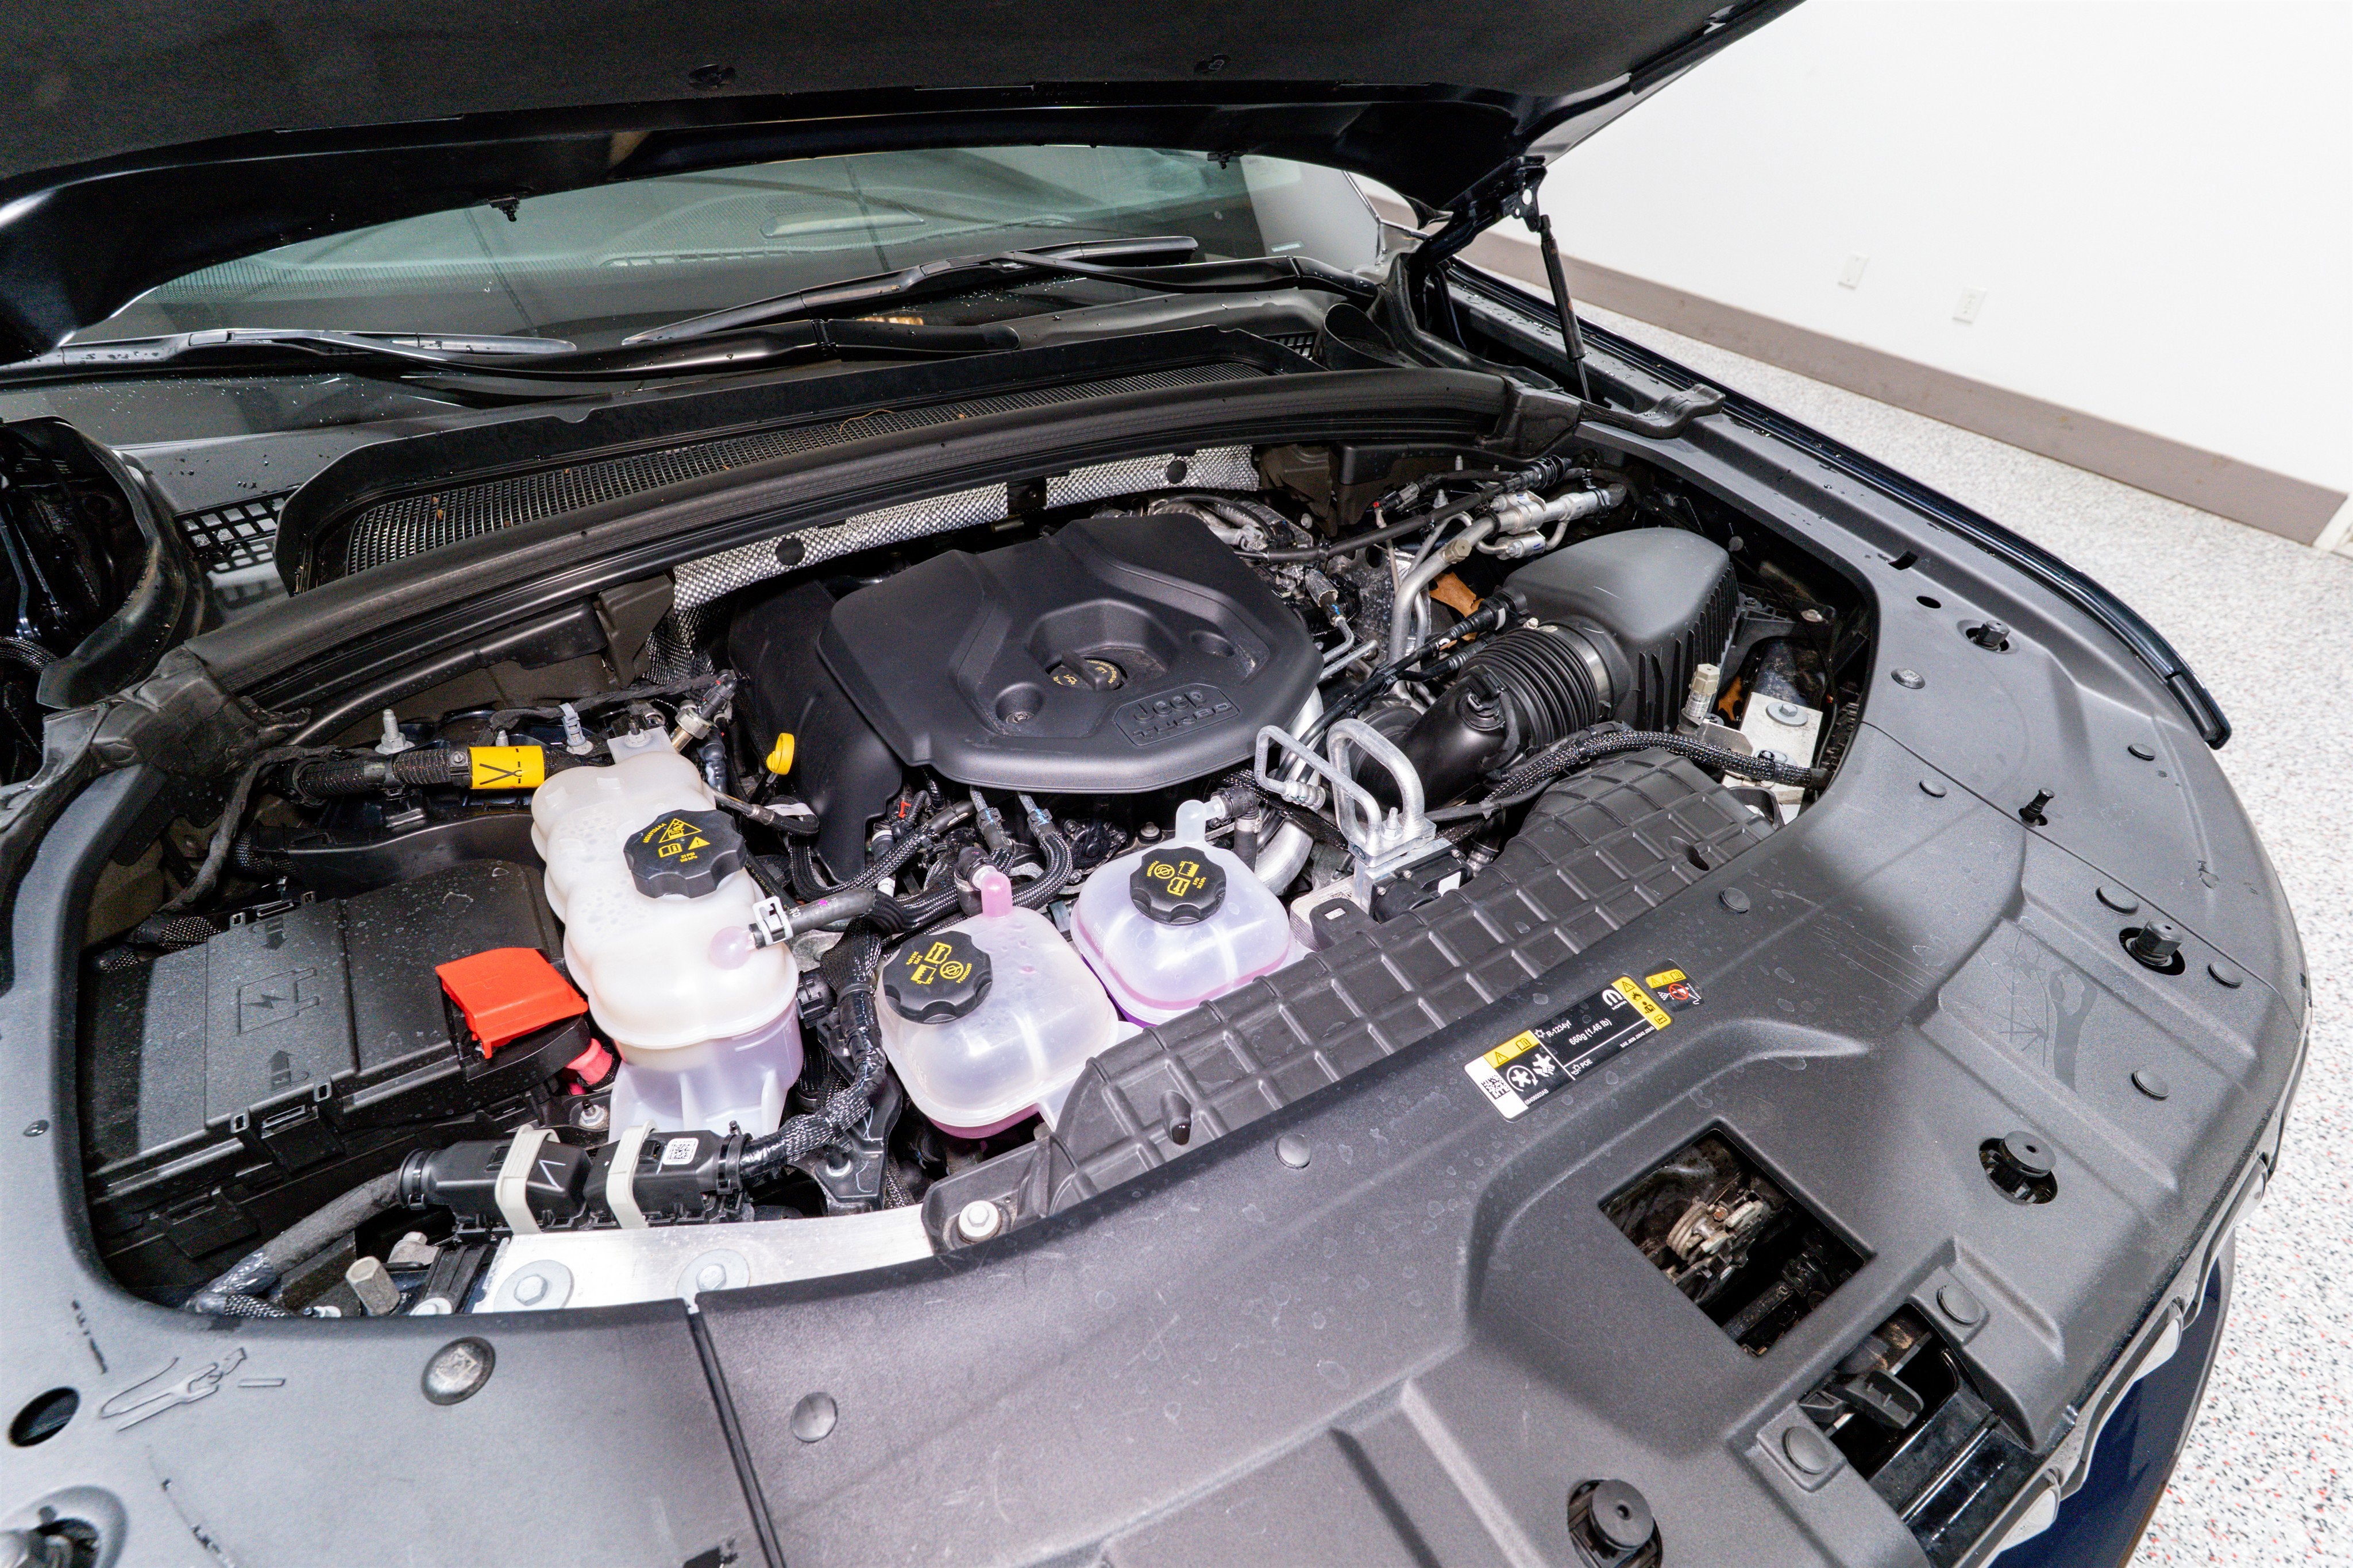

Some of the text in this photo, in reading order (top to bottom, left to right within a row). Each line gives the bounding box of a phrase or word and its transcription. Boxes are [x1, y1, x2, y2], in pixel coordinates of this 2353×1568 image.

[1133, 690, 1207, 723] Jeep
[1546, 1019, 1572, 1037] R-1234yf
[1569, 1018, 1613, 1045] 660g (1.46 lb)
[1580, 1059, 1593, 1069] POE
